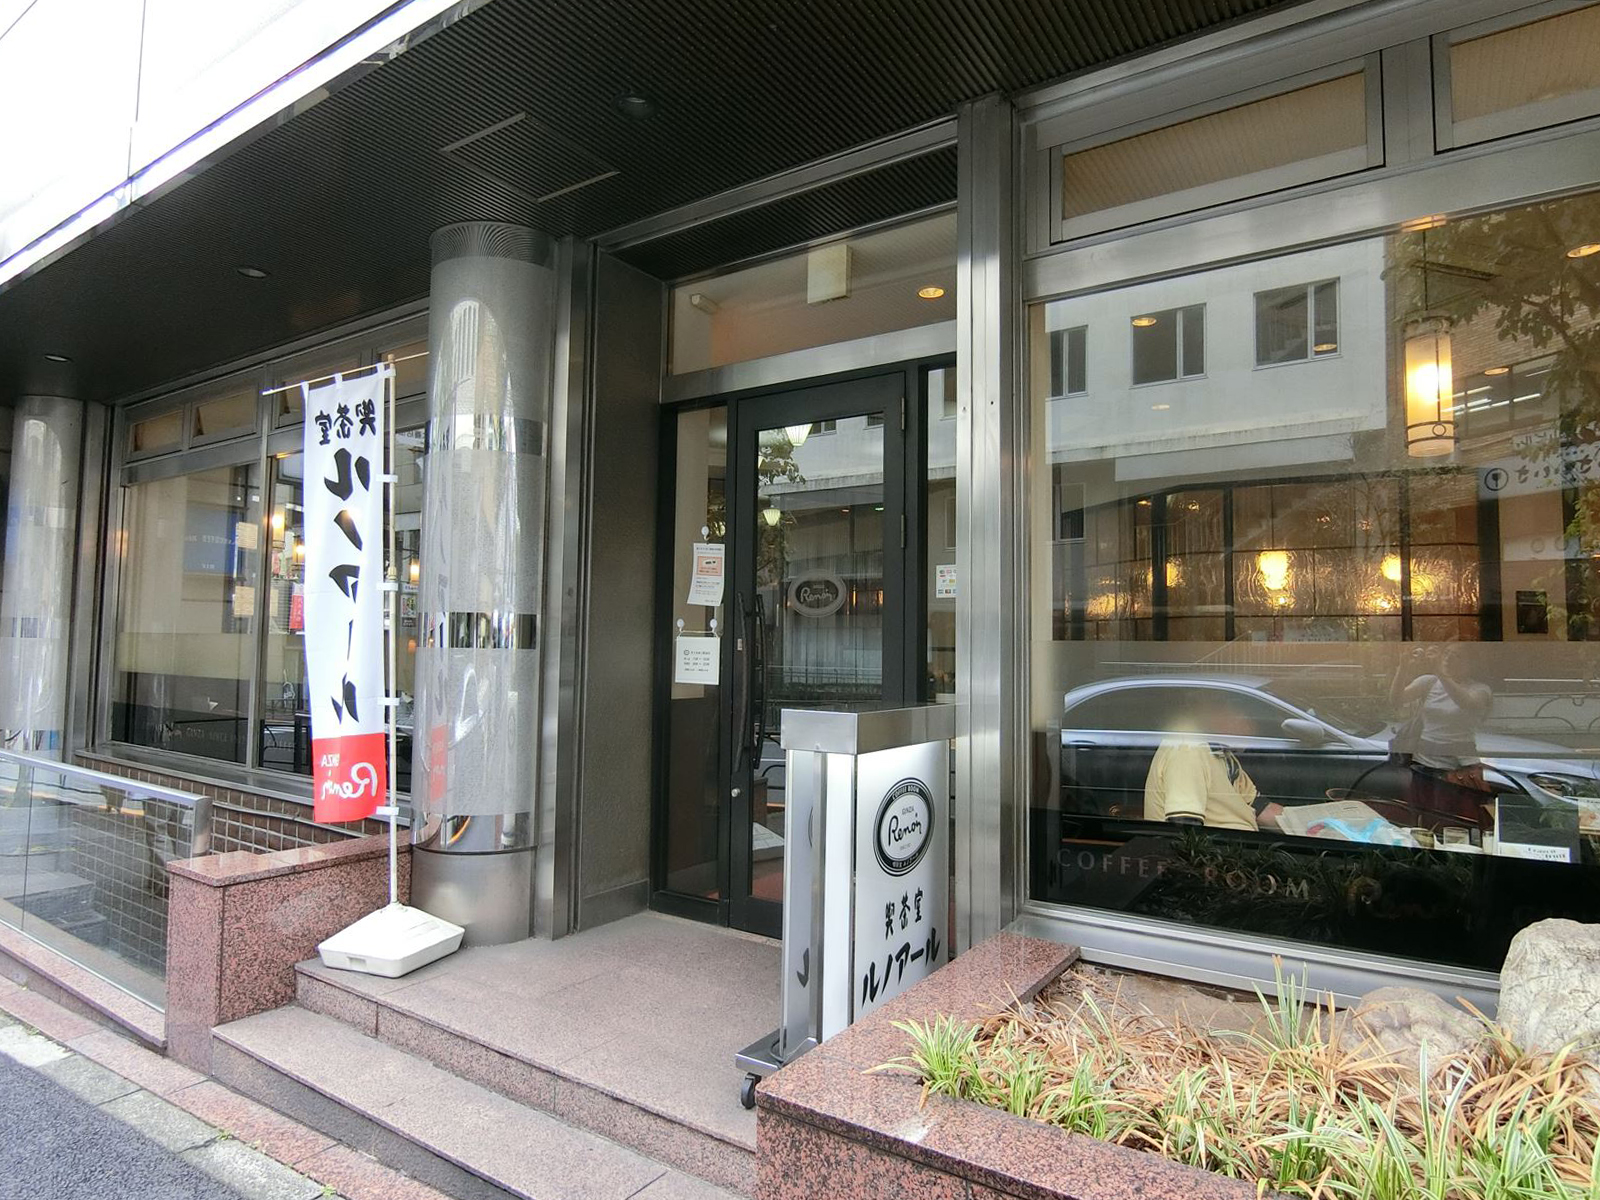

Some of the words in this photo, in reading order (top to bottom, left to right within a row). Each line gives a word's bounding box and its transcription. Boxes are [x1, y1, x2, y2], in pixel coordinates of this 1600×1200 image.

[888, 813, 922, 847] Renoir
[885, 887, 923, 940] 喫茶室
[861, 927, 941, 1008] ルノアール
